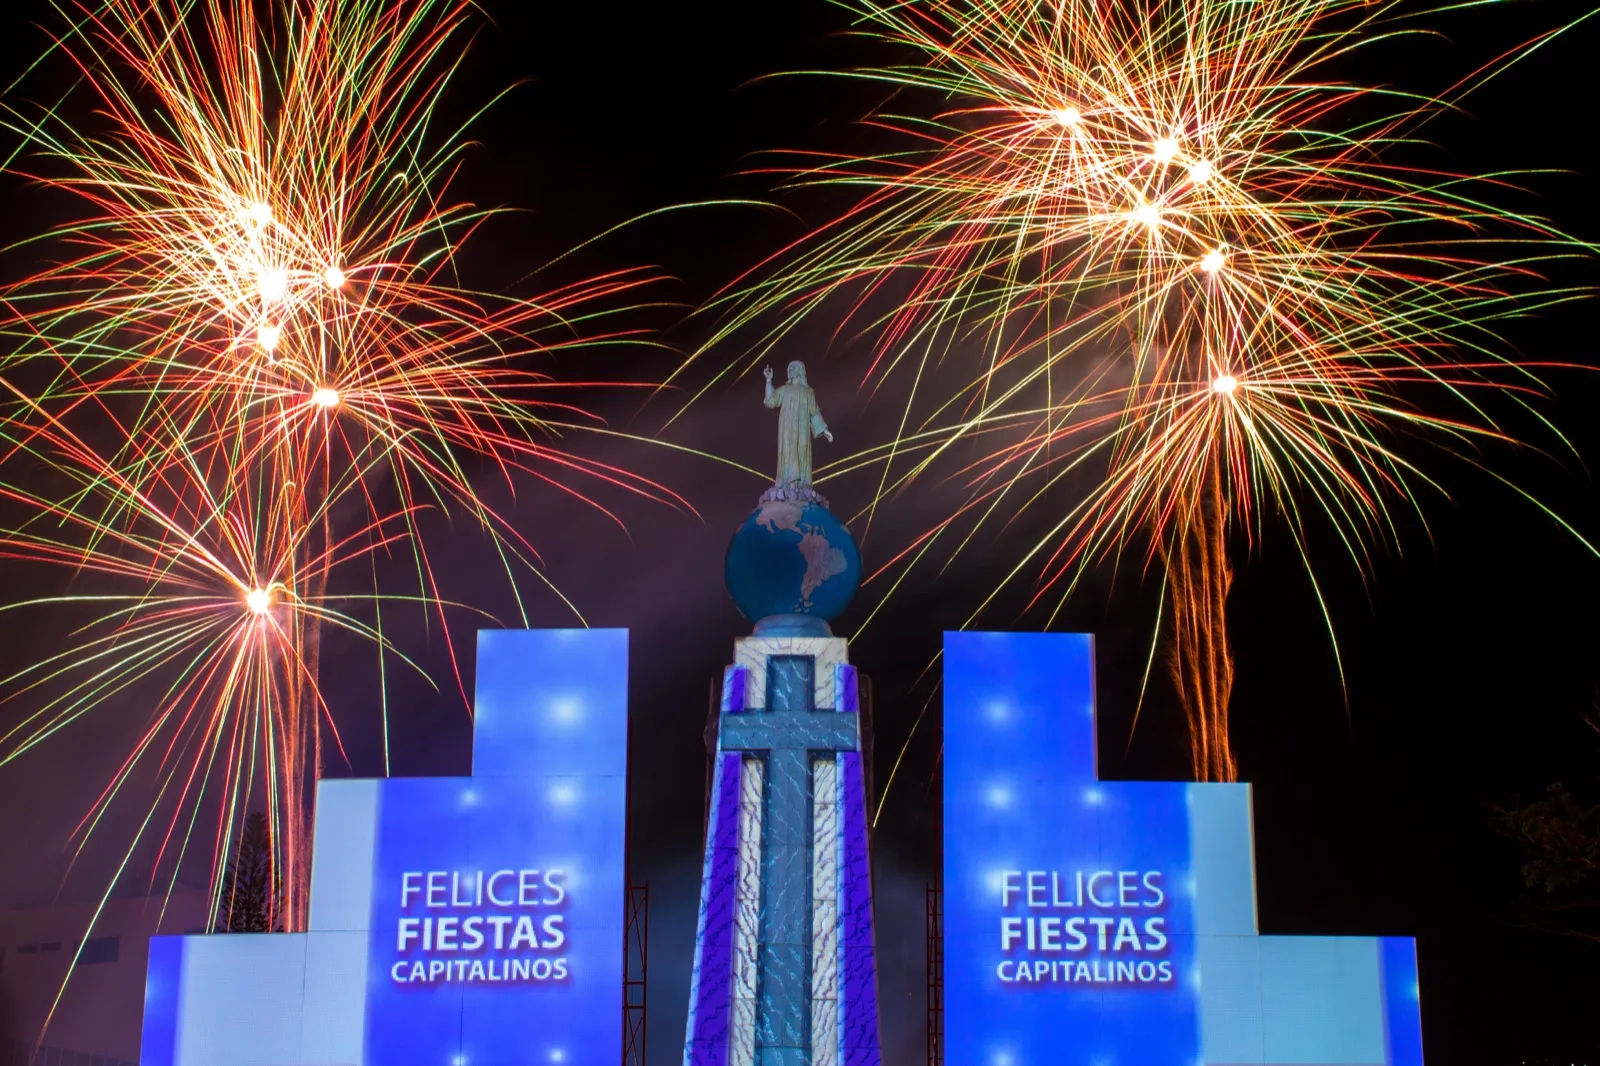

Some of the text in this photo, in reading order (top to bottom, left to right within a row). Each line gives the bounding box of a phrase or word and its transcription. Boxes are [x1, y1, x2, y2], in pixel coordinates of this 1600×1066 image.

[401, 869, 566, 907] FELICES
[1001, 870, 1164, 907] FELICES
[397, 915, 565, 950] FIESTAS
[1001, 917, 1167, 950] FIESTAS
[391, 958, 568, 982] CAPITALINOS
[997, 960, 1172, 982] CAPITALINOS
